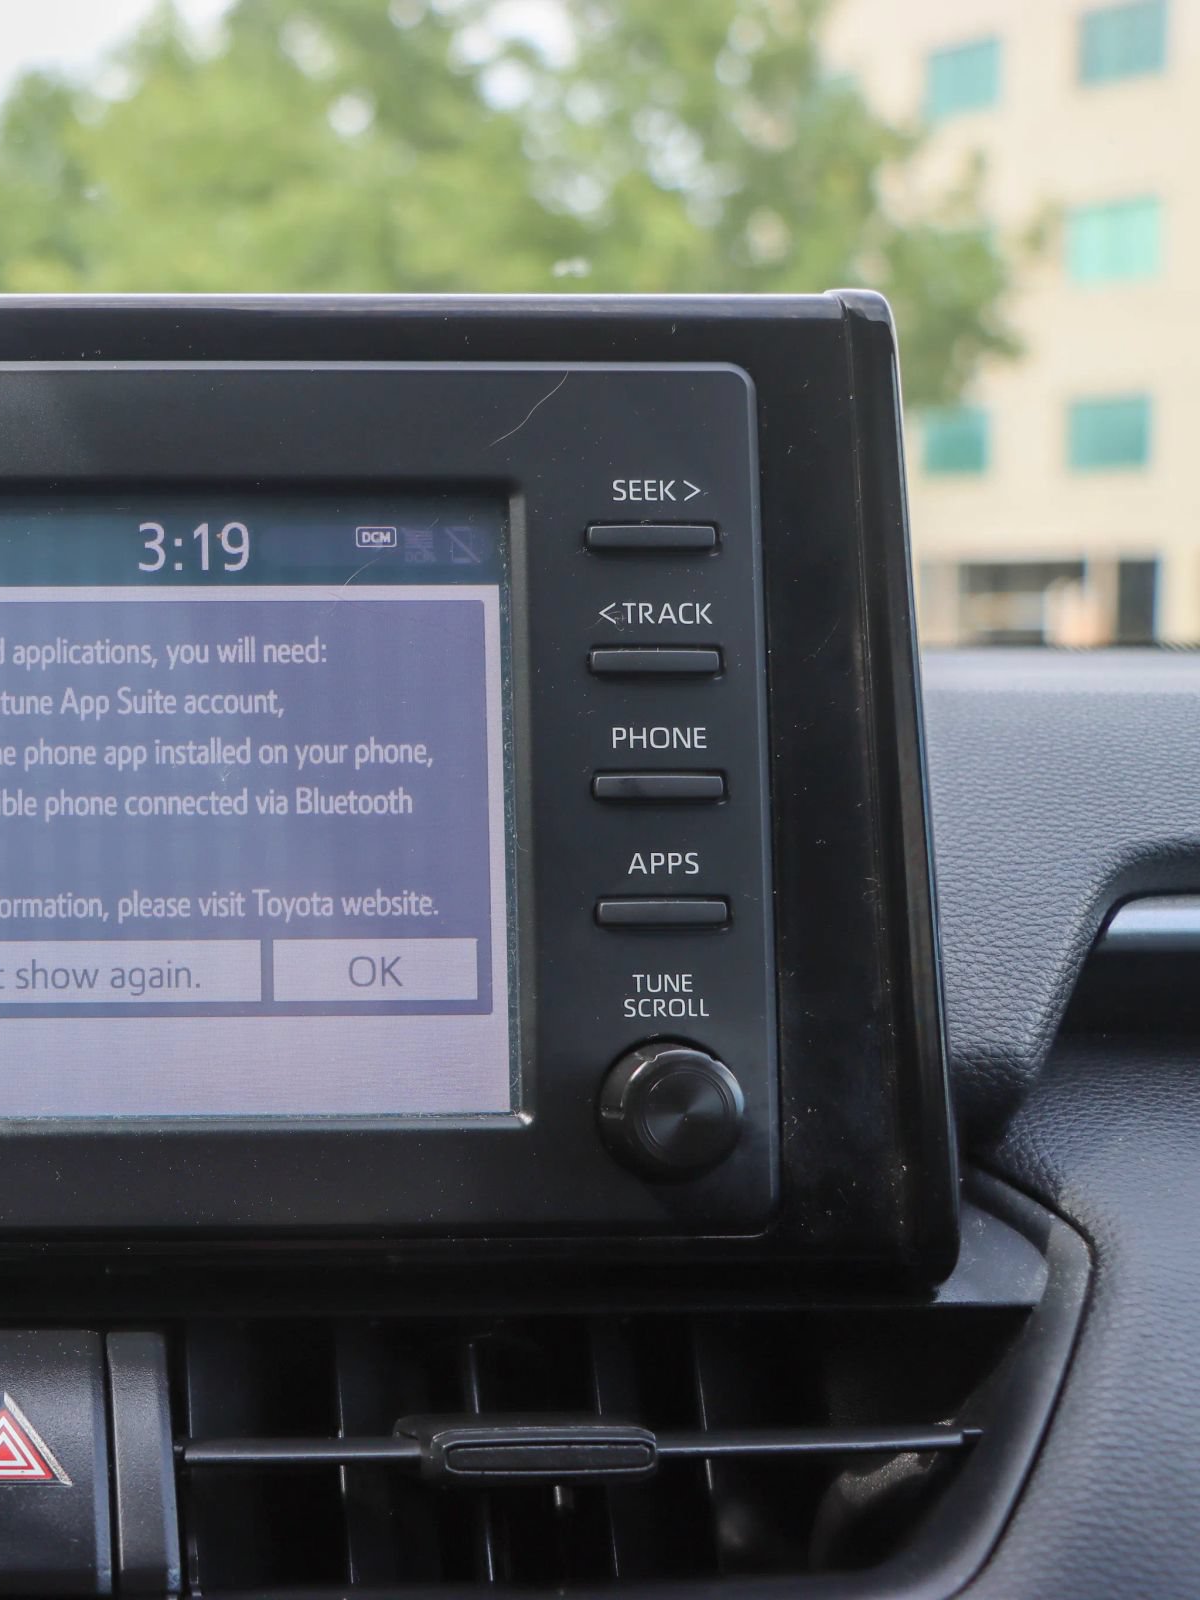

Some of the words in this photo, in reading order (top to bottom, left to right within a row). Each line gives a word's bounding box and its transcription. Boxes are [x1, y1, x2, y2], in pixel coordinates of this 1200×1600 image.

[137, 521, 252, 573] 3:19
[361, 530, 393, 545] DCM
[13, 637, 159, 672] applications,
[167, 645, 210, 671] you
[217, 637, 257, 666] will
[264, 637, 328, 666] need:
[60, 688, 111, 722] App
[118, 686, 178, 716] Suite
[184, 688, 286, 721] account,
[25, 737, 98, 773] phone
[104, 745, 149, 773] app
[155, 736, 252, 767] installed
[259, 745, 289, 766] on
[295, 745, 350, 773] your
[355, 736, 434, 773] phone,
[611, 726, 709, 750] PHONE
[45, 788, 119, 826] phone
[125, 787, 249, 817] connected
[255, 788, 290, 817] via
[296, 786, 414, 816] Bluetooth
[627, 852, 701, 876] APPS
[117, 889, 192, 925] please
[199, 889, 247, 919] visit
[252, 888, 335, 924] Toyota
[341, 888, 441, 919] website.
[16, 958, 101, 991] show
[109, 959, 203, 998] again.
[348, 955, 404, 989] OK
[632, 973, 695, 995] TUNE
[623, 998, 711, 1020] SCROLL
